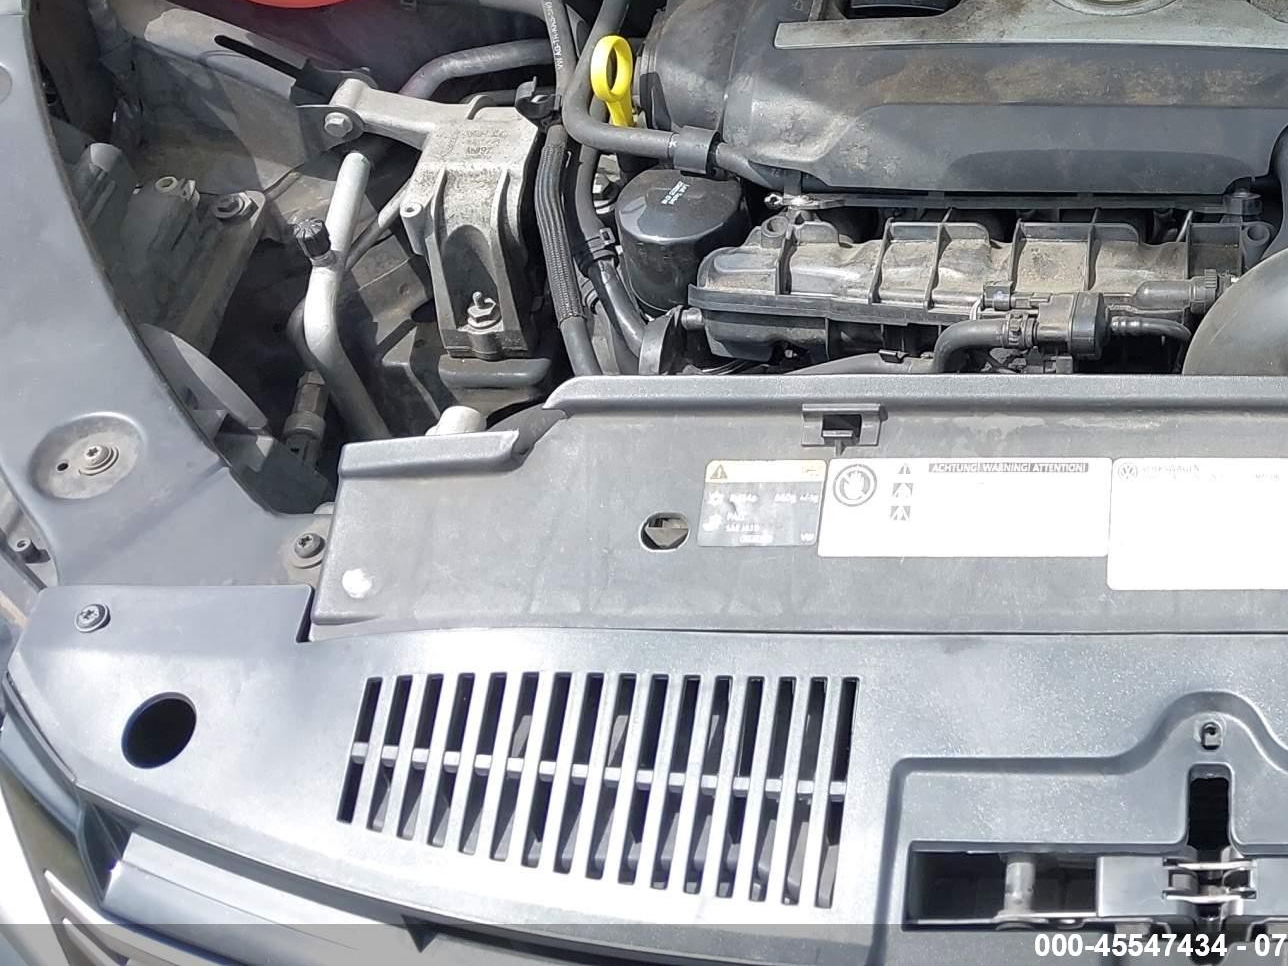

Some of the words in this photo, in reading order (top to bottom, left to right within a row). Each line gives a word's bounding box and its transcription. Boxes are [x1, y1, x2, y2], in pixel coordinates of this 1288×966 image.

[933, 462, 979, 473] ACHTUNG!
[982, 462, 1031, 473] WARNING!
[1032, 462, 1086, 473] ATTENTION!
